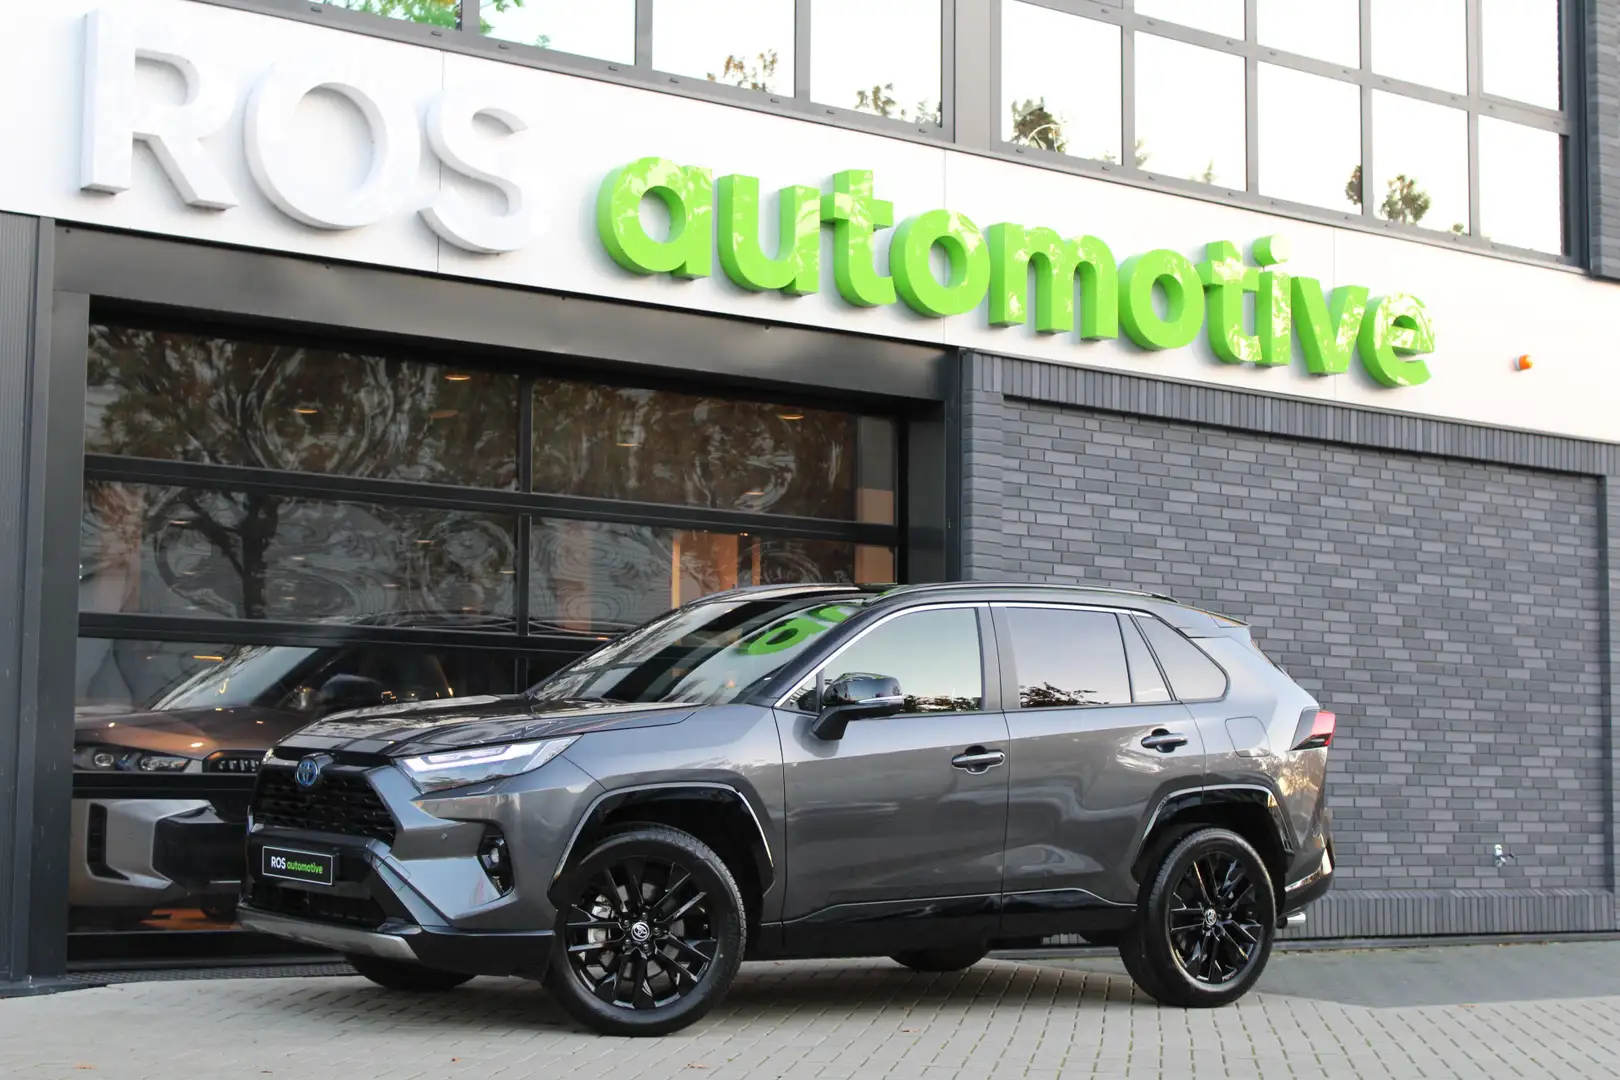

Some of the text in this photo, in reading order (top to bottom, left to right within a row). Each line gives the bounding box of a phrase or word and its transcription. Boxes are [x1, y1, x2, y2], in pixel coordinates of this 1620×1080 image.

[80, 8, 1436, 388] ROS automotive
[271, 855, 324, 874] ROS automotive
